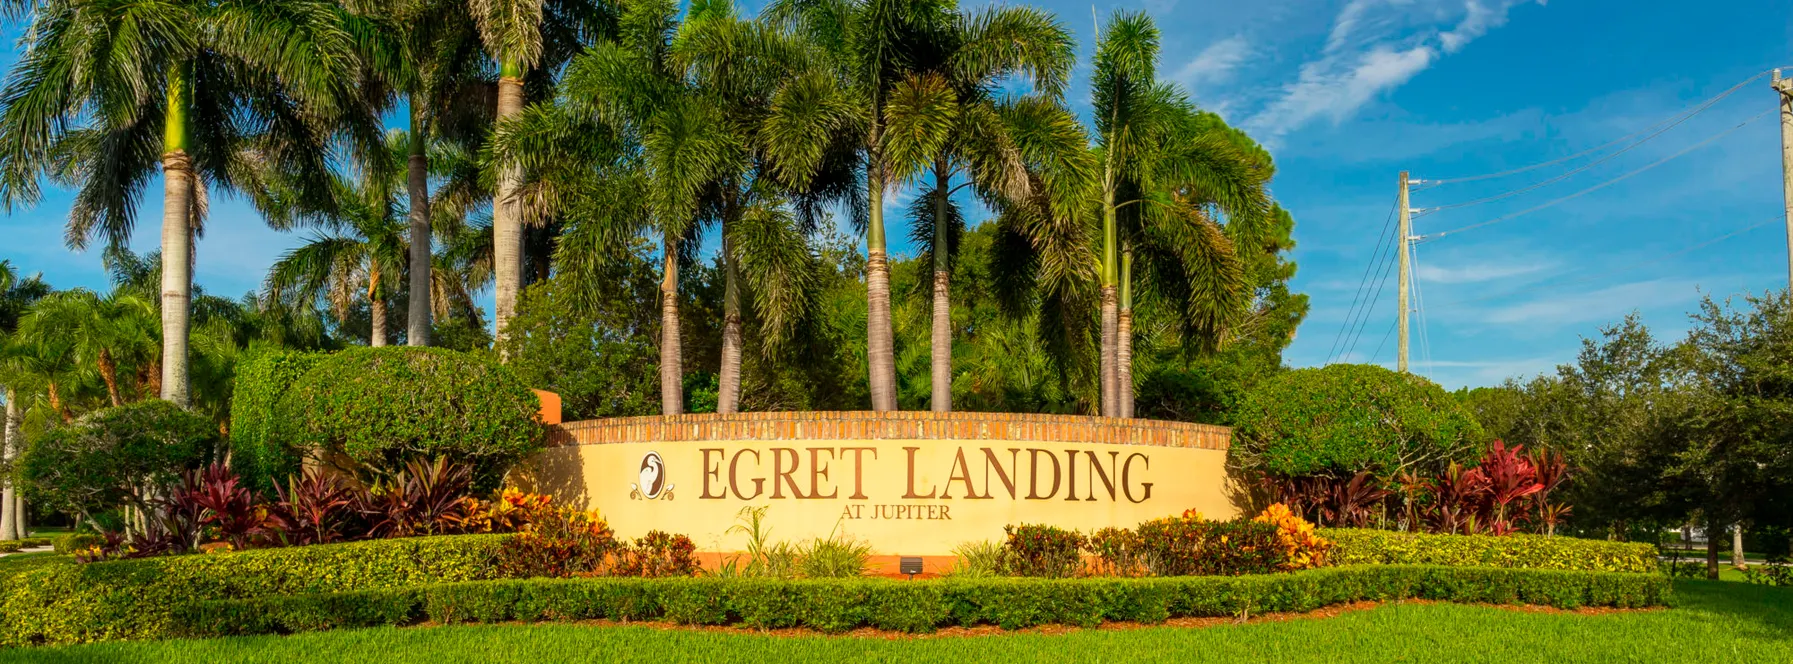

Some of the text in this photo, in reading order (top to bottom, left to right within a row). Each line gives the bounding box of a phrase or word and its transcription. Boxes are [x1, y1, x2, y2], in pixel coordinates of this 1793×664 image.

[699, 446, 1154, 503] EGRET LANDING
[841, 504, 952, 521] AT JUPITER
